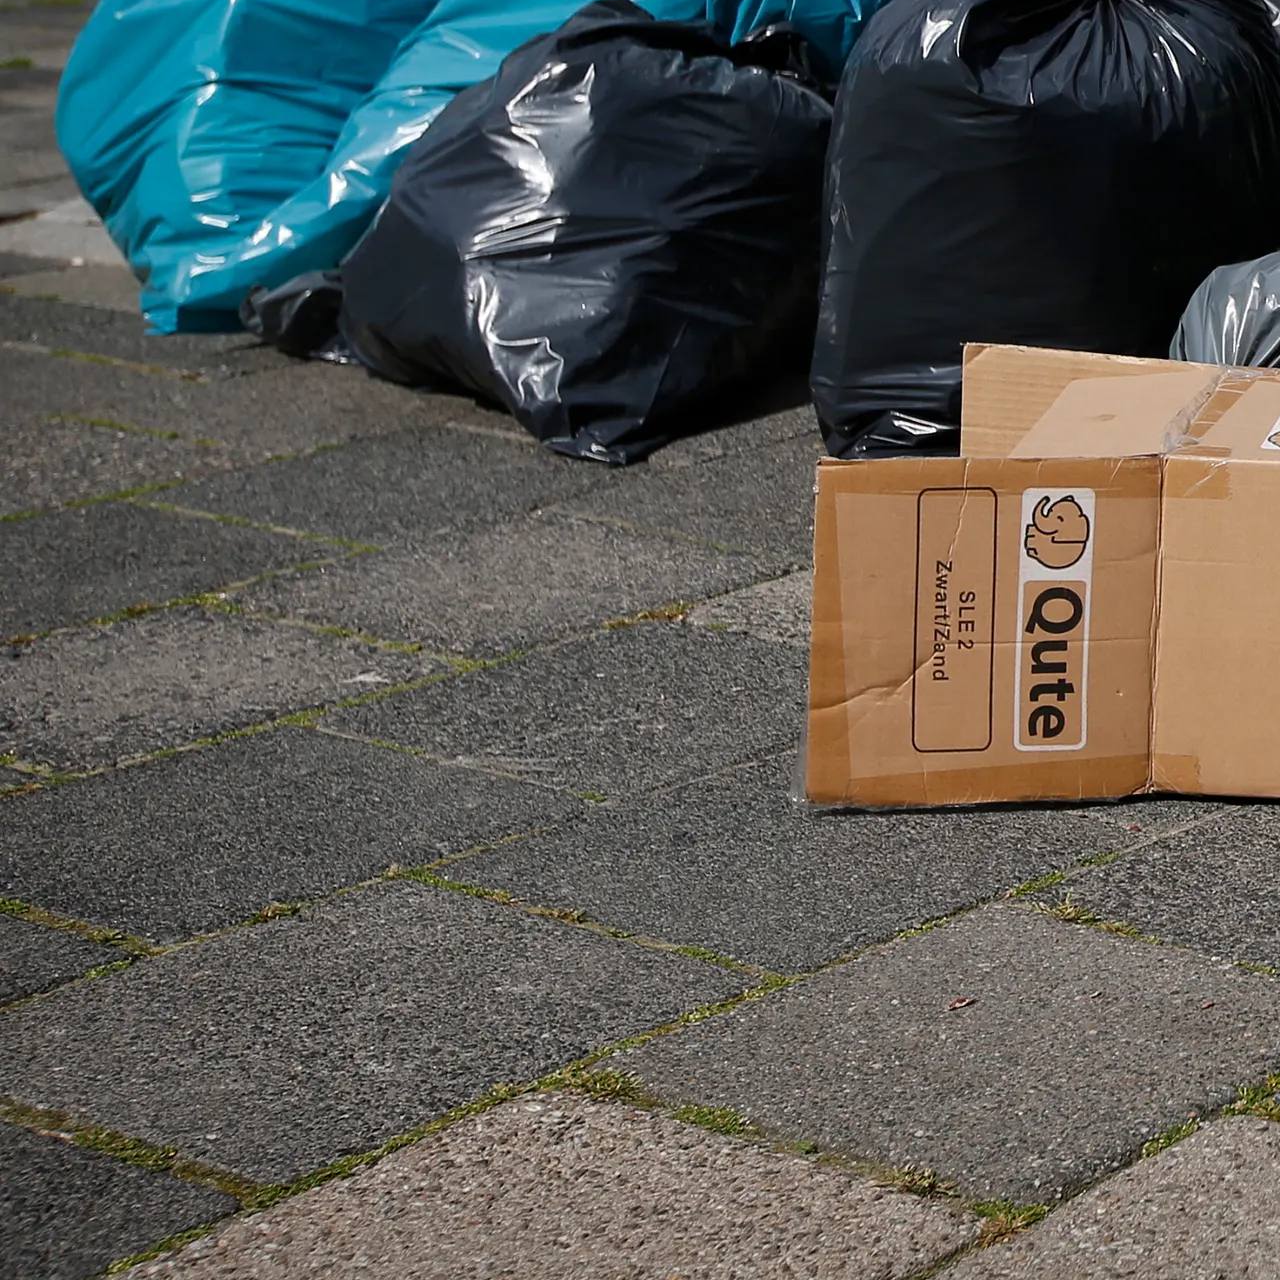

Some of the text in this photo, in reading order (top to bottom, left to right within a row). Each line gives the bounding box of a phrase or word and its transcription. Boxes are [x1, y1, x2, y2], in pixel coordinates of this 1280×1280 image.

[933, 560, 953, 681] Zwart/Zand
[958, 591, 975, 650] SLE 2
[1025, 587, 1083, 739] Qute
